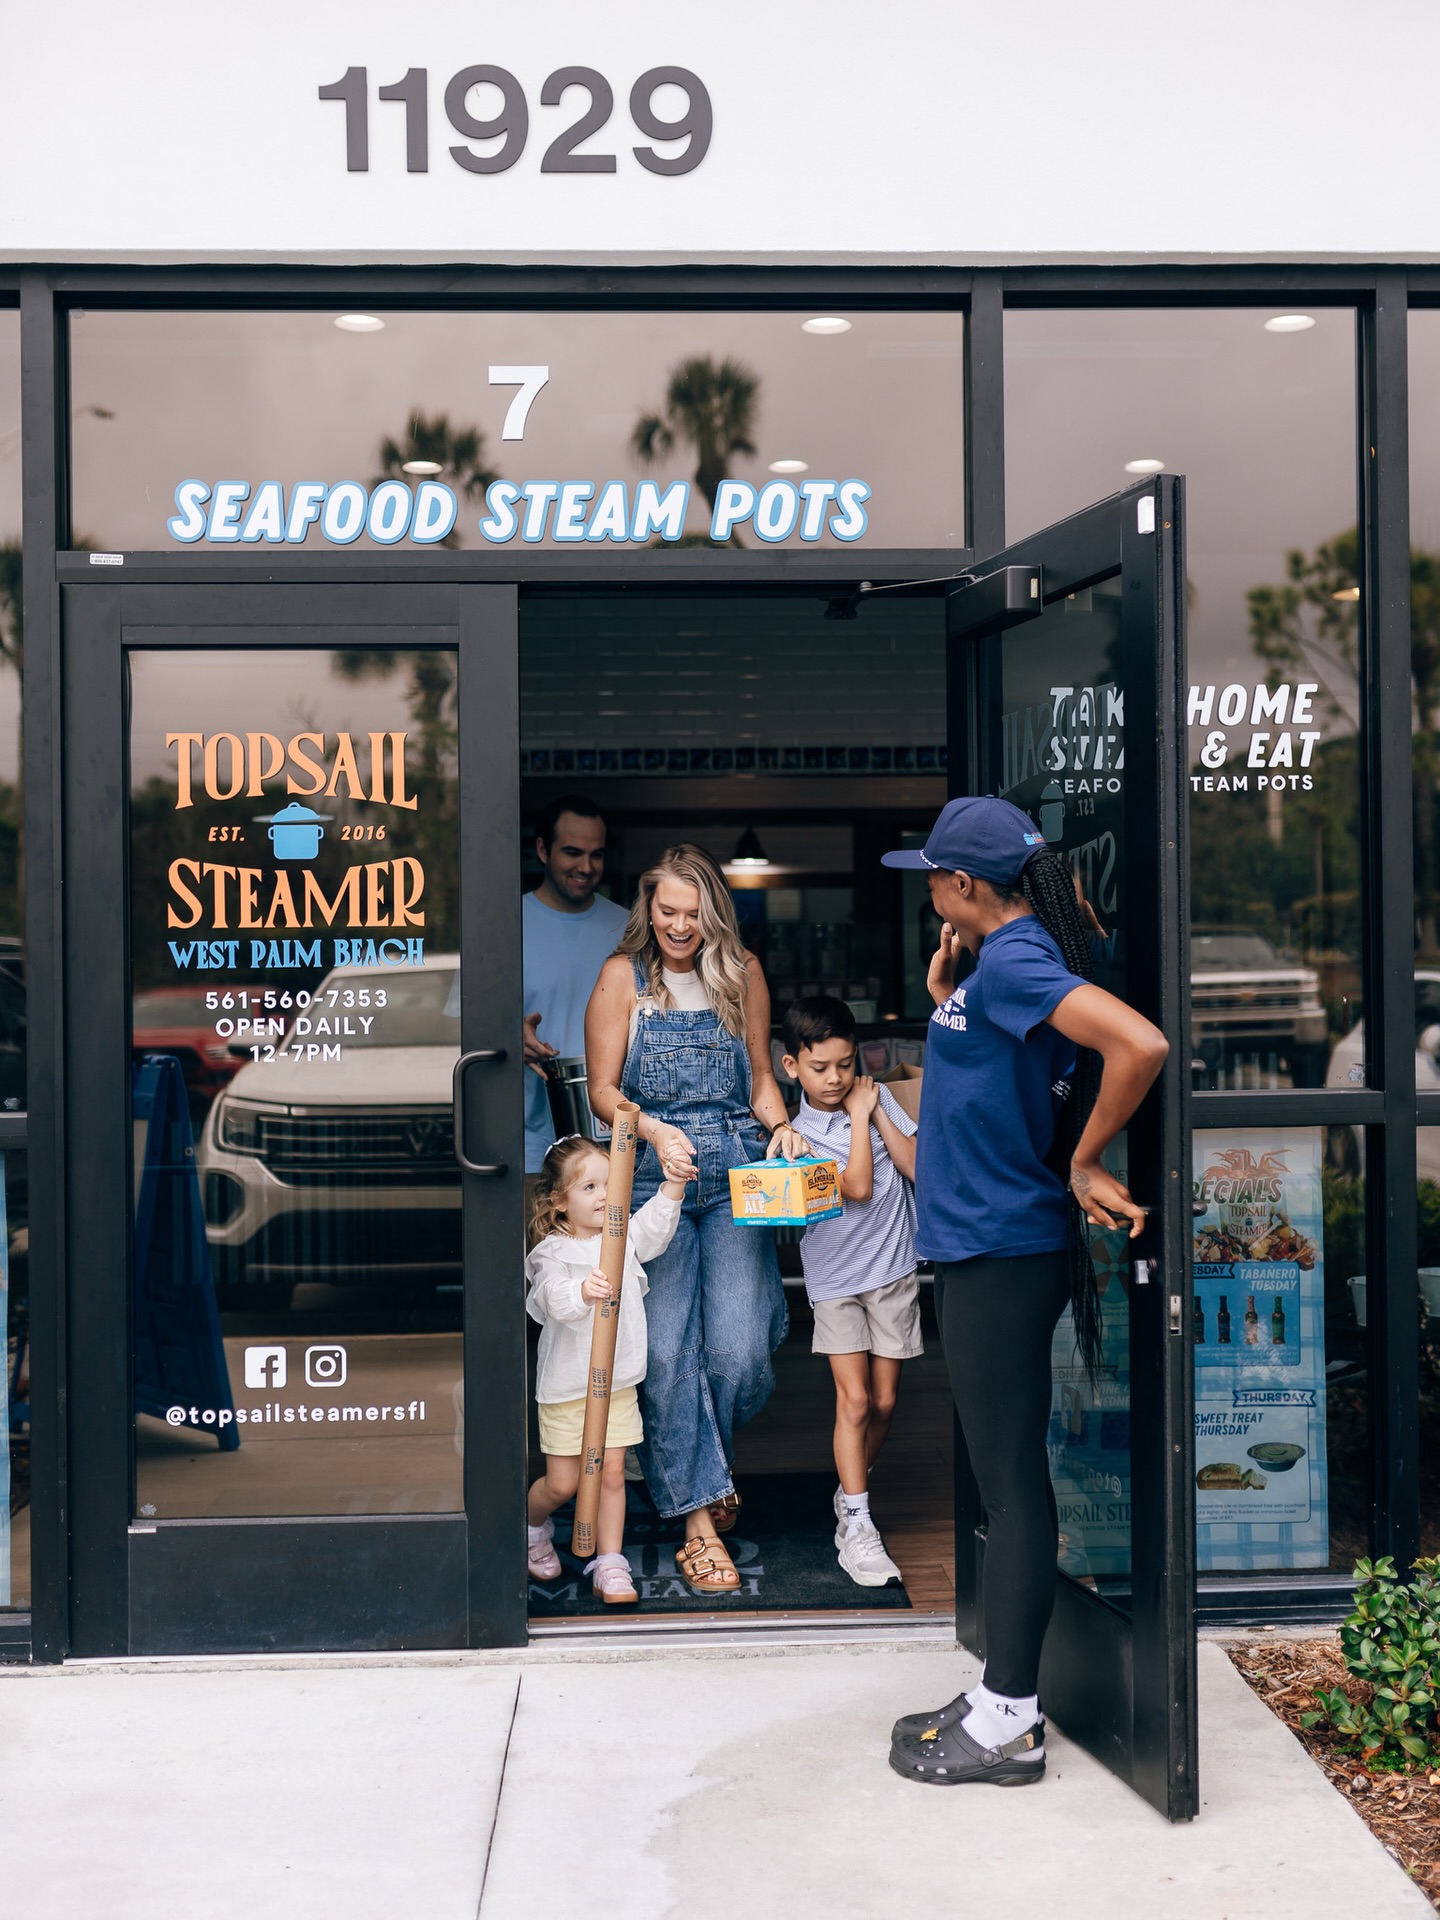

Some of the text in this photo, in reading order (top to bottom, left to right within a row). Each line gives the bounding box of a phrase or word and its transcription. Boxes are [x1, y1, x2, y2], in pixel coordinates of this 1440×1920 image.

[318, 64, 714, 177] 11929
[488, 365, 549, 442] 7
[167, 478, 872, 545] SEAFOOD STEAM POTS
[1050, 683, 1319, 728] TAK HOME
[1046, 731, 1320, 771] STE & EAT
[165, 732, 418, 811] TOPSAIL
[1064, 774, 1314, 794] EAFO TEAM POTS
[208, 825, 387, 842] EST. 2016
[167, 857, 426, 929] STEAMER
[168, 938, 425, 969] WEST PALM BEACH
[205, 989, 388, 1010] 561-560-7353
[215, 1016, 375, 1038] OPEN DAILY
[250, 1043, 342, 1063] 12-7PM
[1193, 1178, 1284, 1204] ECIALS
[745, 1200, 767, 1214] ALE
[1229, 1205, 1266, 1217] TOPSAIL
[1250, 1280, 1297, 1291] TUESDAY
[1242, 1392, 1306, 1402] THURSDAY
[165, 1401, 428, 1427] @topsailsteamersfl
[1195, 1412, 1265, 1424] SWEET TREAT
[1195, 1424, 1250, 1436] THURSDAY
[641, 1579, 762, 1598] EAH
